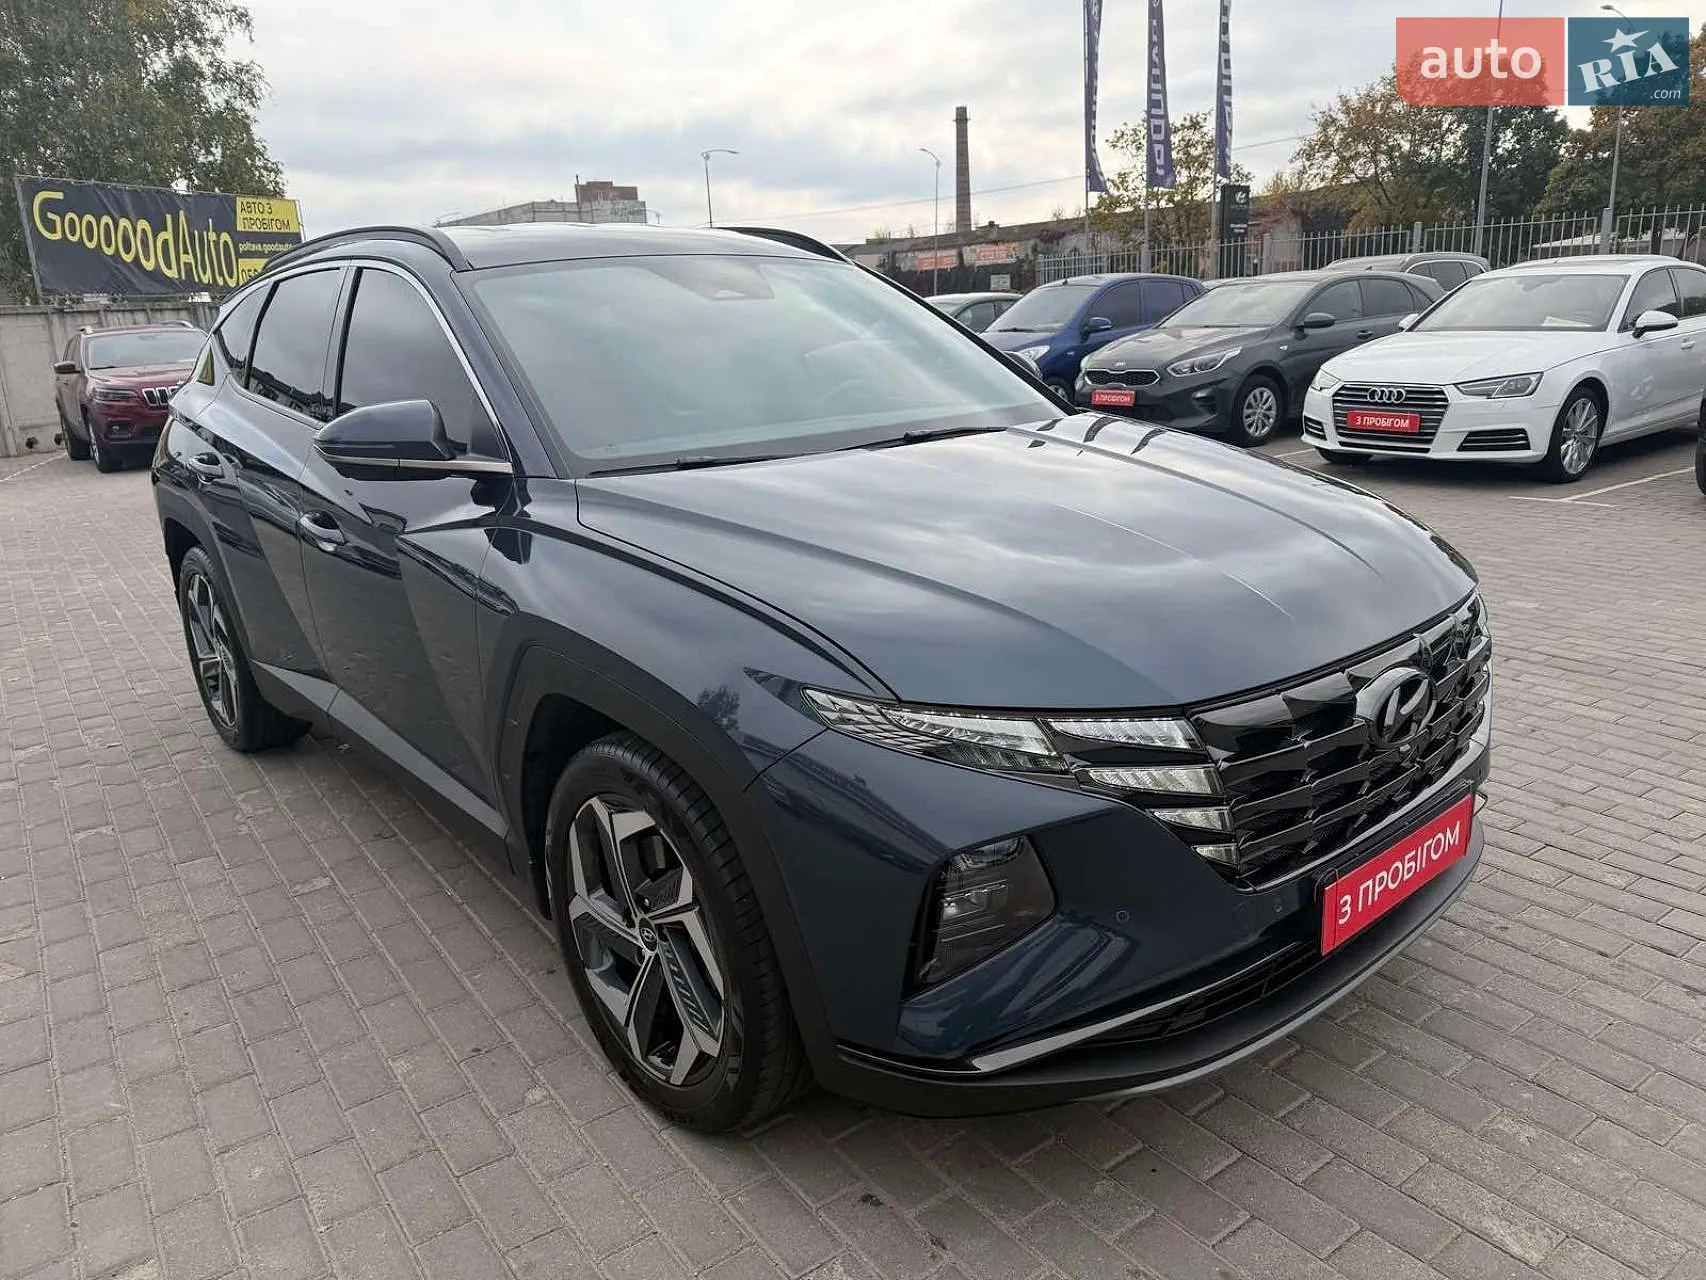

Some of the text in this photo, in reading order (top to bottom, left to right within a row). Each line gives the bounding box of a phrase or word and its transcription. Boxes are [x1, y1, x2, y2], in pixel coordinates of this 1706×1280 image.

[240, 201, 265, 214] АВТО
[242, 217, 291, 230] ПРОБІГОМ
[1364, 416, 1410, 428] ПРОБІГОМ
[1357, 820, 1461, 913] ПРОБІГОМ
